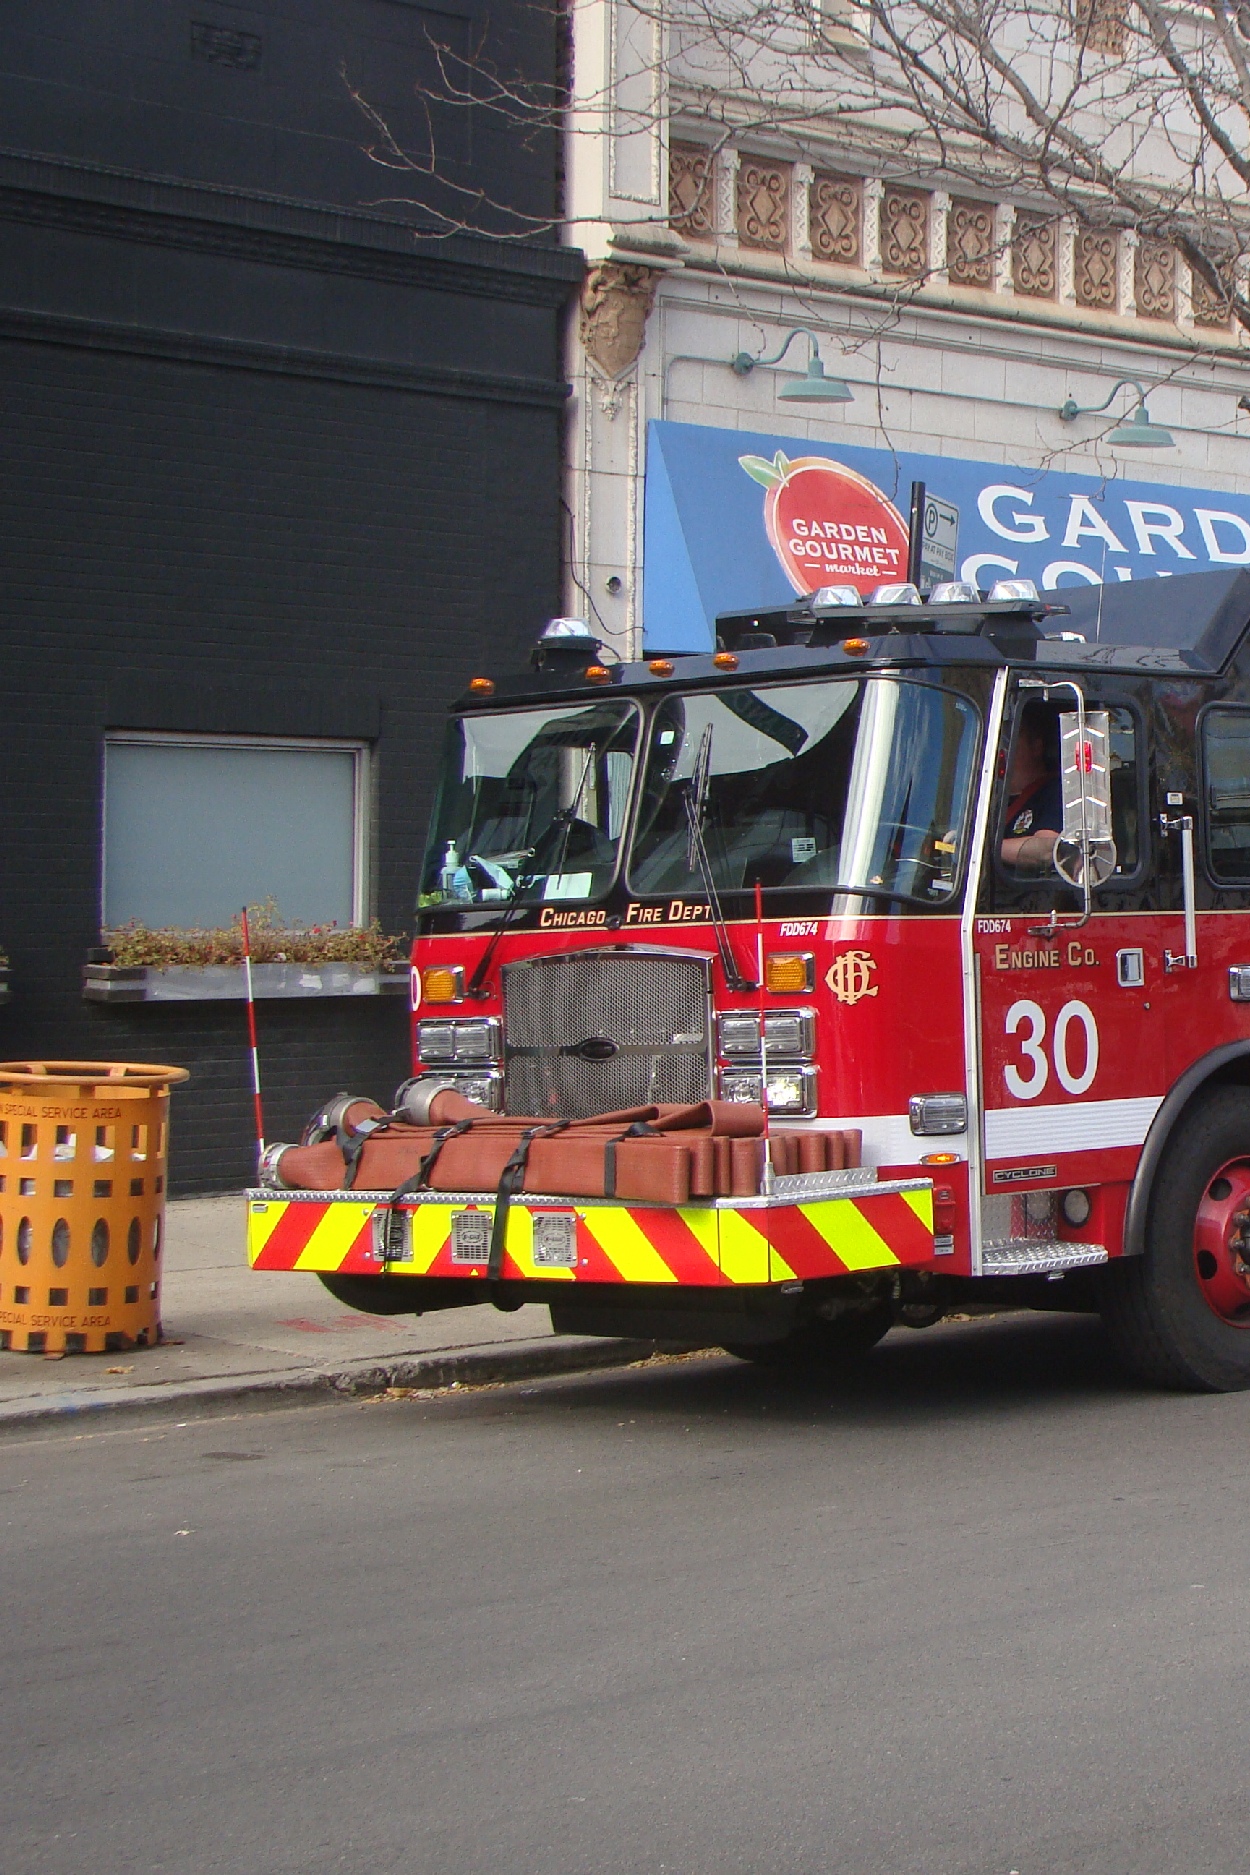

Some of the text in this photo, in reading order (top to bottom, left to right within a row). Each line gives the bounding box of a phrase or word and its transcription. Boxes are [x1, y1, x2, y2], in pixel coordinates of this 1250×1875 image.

[792, 518, 888, 544] GARDEN
[789, 539, 900, 565] GOURMET
[825, 563, 881, 577] market
[780, 922, 819, 936] FDD674
[978, 919, 1012, 933] FDD674
[1004, 999, 1099, 1100] 30
[4, 1103, 38, 1117] SPECIAL
[41, 1106, 88, 1119] SERVICE
[92, 1107, 122, 1119] AREA
[995, 1167, 1055, 1180] CYCLONE
[31, 1314, 76, 1327] SERVICE
[81, 1315, 111, 1327] AREA
